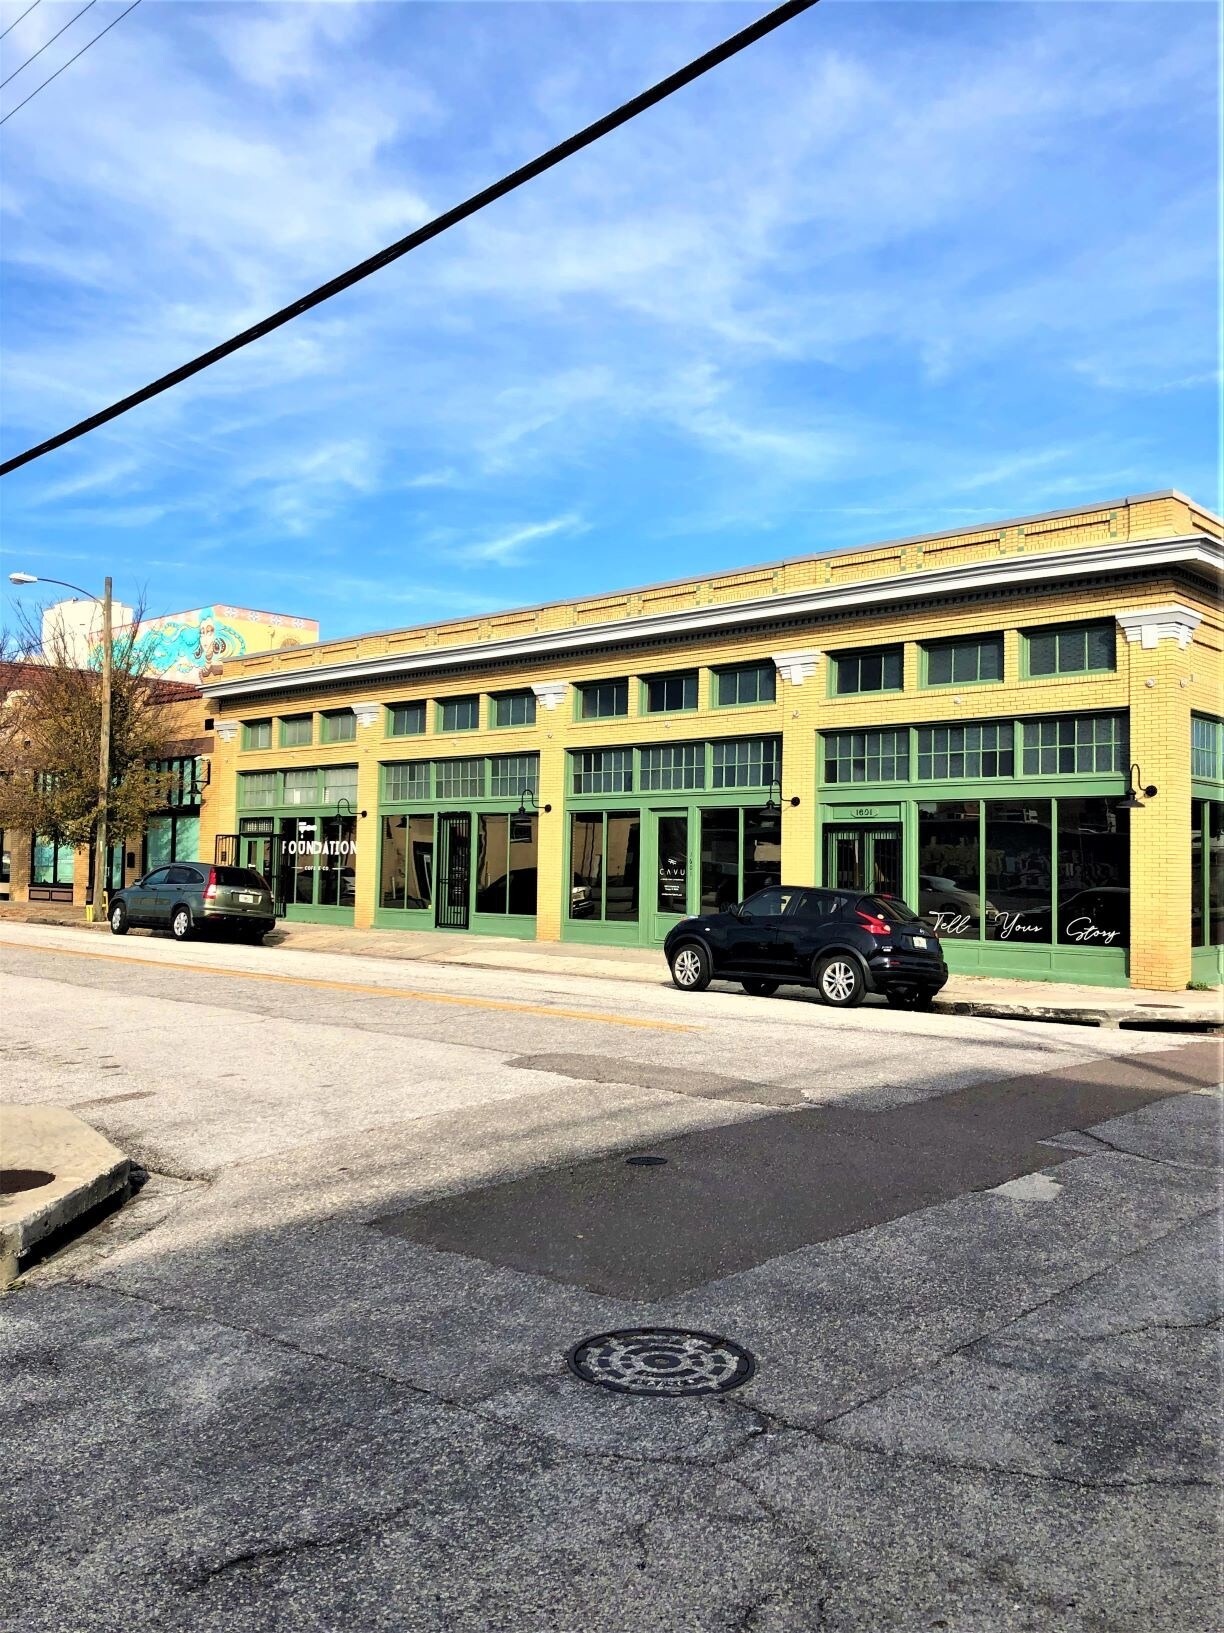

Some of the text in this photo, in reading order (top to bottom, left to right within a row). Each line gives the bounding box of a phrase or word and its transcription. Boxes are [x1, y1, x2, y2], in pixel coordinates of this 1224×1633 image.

[282, 841, 358, 855] FOUNDATION
[659, 868, 686, 876] CAVU
[928, 910, 1121, 944] Tell Your Story
